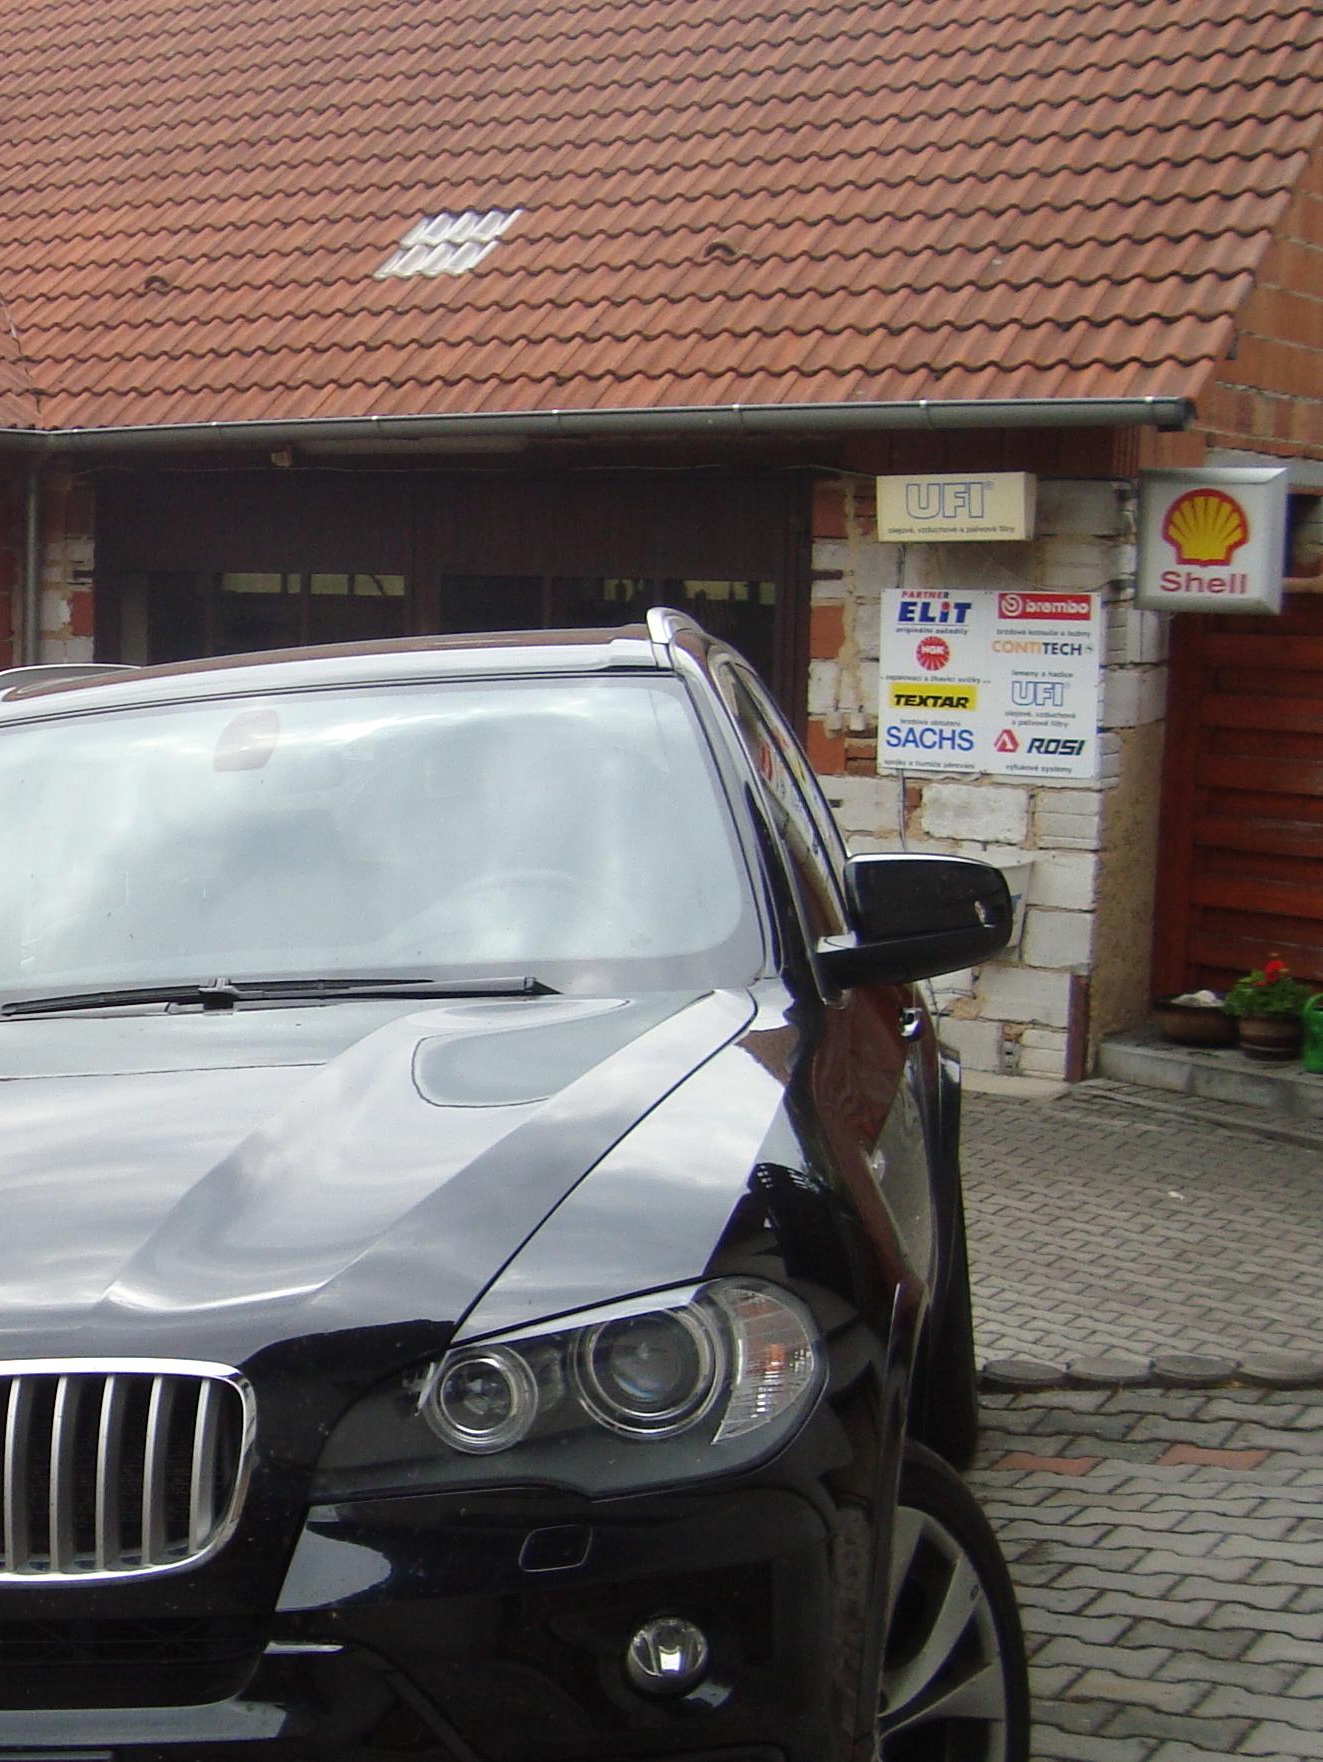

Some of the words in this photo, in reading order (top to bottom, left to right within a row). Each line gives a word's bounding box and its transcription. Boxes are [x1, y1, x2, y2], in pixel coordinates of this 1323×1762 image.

[905, 481, 984, 519] UFI
[1160, 571, 1247, 594] Shell
[901, 591, 949, 599] PARTNER
[1025, 599, 1089, 614] brembo
[894, 694, 969, 708] TEXTAR
[1011, 681, 1064, 706] UFI
[886, 726, 974, 751] SACHS
[1026, 738, 1086, 756] ROSI
